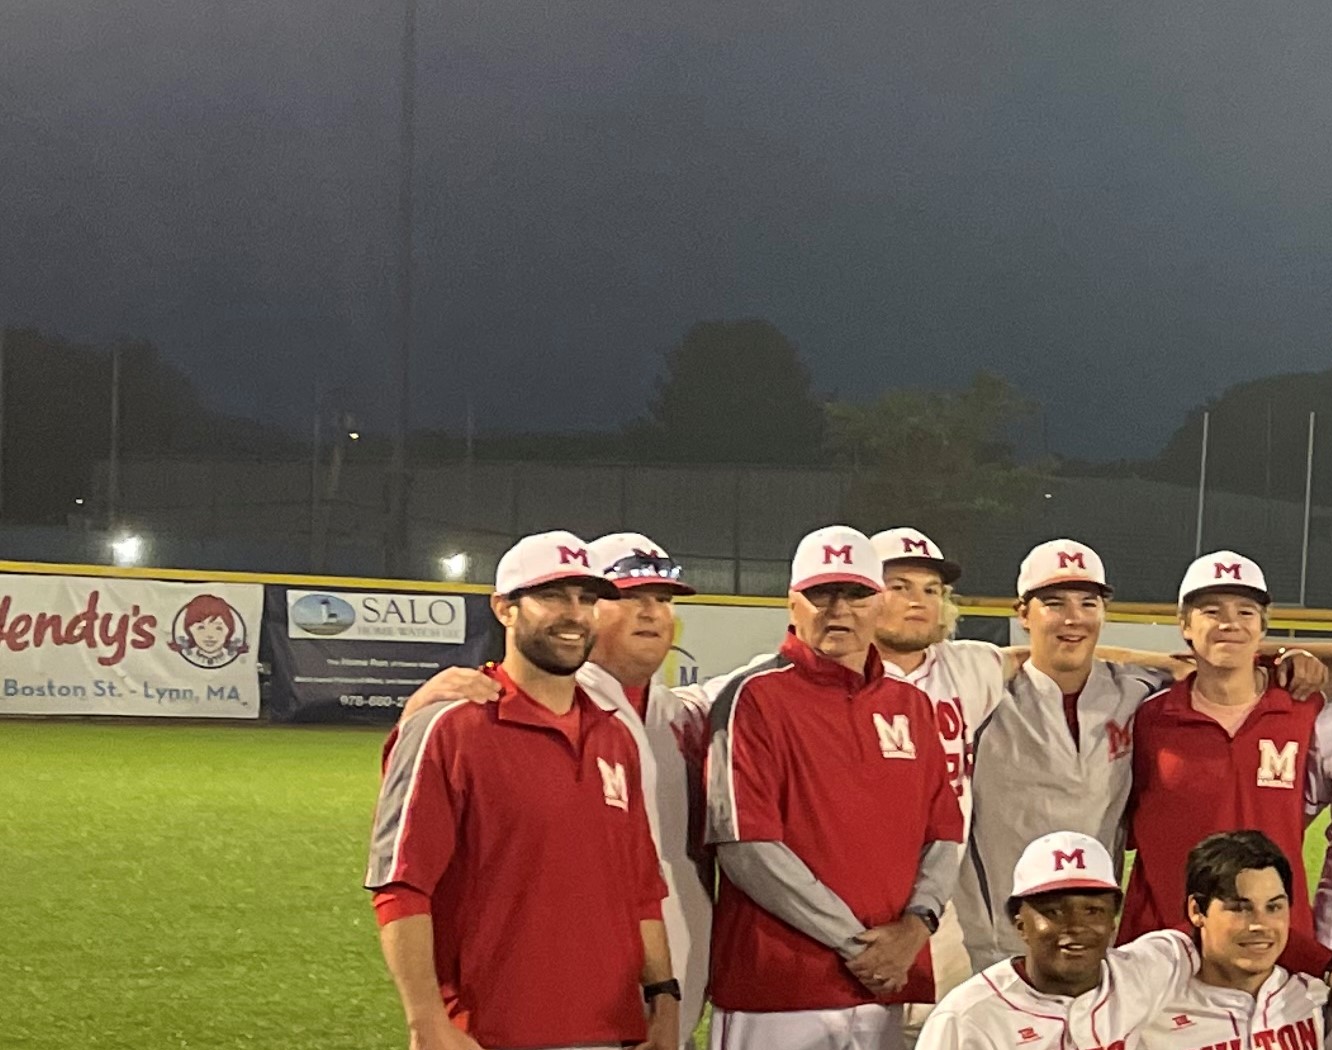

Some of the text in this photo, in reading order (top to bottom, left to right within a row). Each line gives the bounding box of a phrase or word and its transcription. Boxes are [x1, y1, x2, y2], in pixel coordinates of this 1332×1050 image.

[557, 545, 590, 568] M
[822, 544, 853, 564] M
[901, 538, 931, 558] M
[1057, 551, 1087, 569] M
[1213, 562, 1242, 580] M
[362, 597, 455, 626] SALO
[0, 591, 157, 666] endy's
[4, 679, 86, 698] Boston
[93, 680, 122, 697] St.
[207, 685, 241, 701] MA
[873, 713, 917, 759] M
[1256, 738, 1300, 788] M
[597, 757, 629, 811] M
[1053, 847, 1087, 870] M
